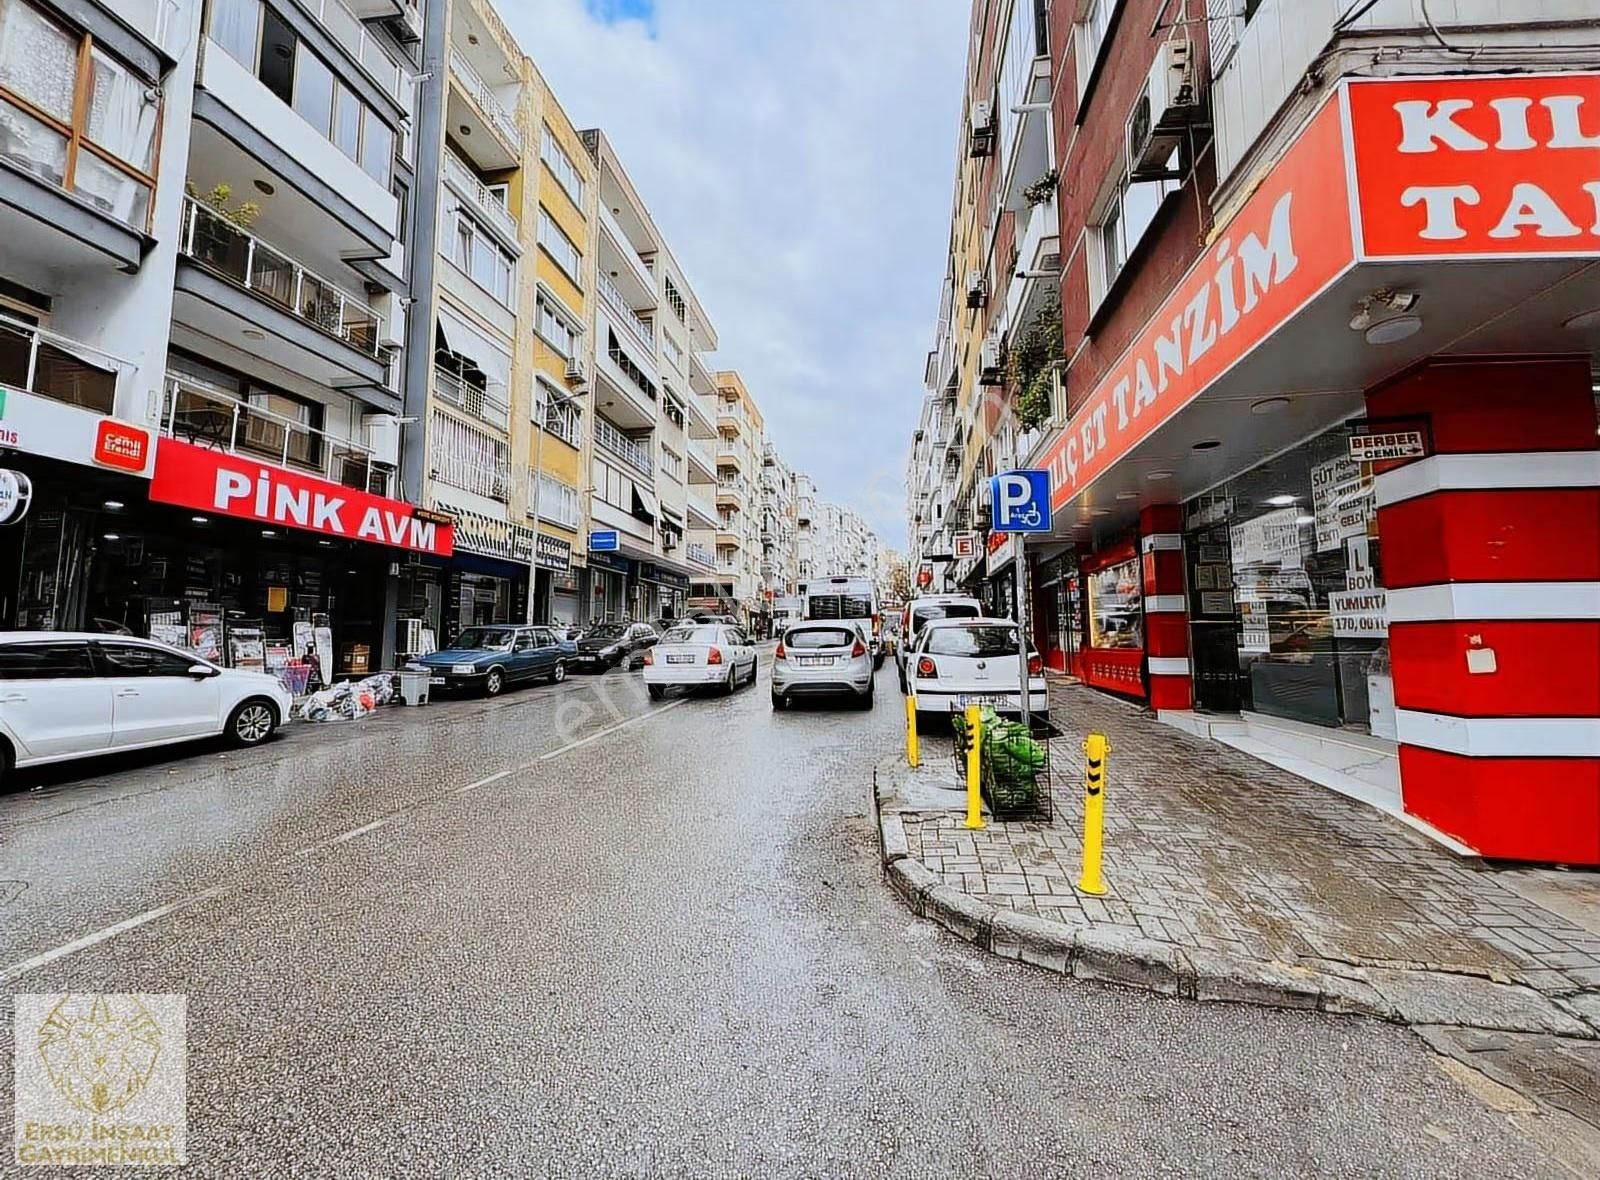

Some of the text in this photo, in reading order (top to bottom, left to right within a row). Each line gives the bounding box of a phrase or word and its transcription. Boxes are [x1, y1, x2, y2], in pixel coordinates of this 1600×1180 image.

[1393, 95, 1600, 153] KIL
[1401, 181, 1600, 240] TA
[1081, 400, 1107, 465] ET
[1113, 192, 1298, 431] TANZİM
[104, 441, 141, 458] Efendi
[1352, 433, 1418, 449] BERBER
[1364, 446, 1406, 459] CEMİL
[1313, 466, 1334, 487] SÜT
[214, 467, 436, 552] PİNK AVM
[998, 475, 1032, 525] P
[1354, 548, 1365, 572] L
[1348, 575, 1373, 590] BOY
